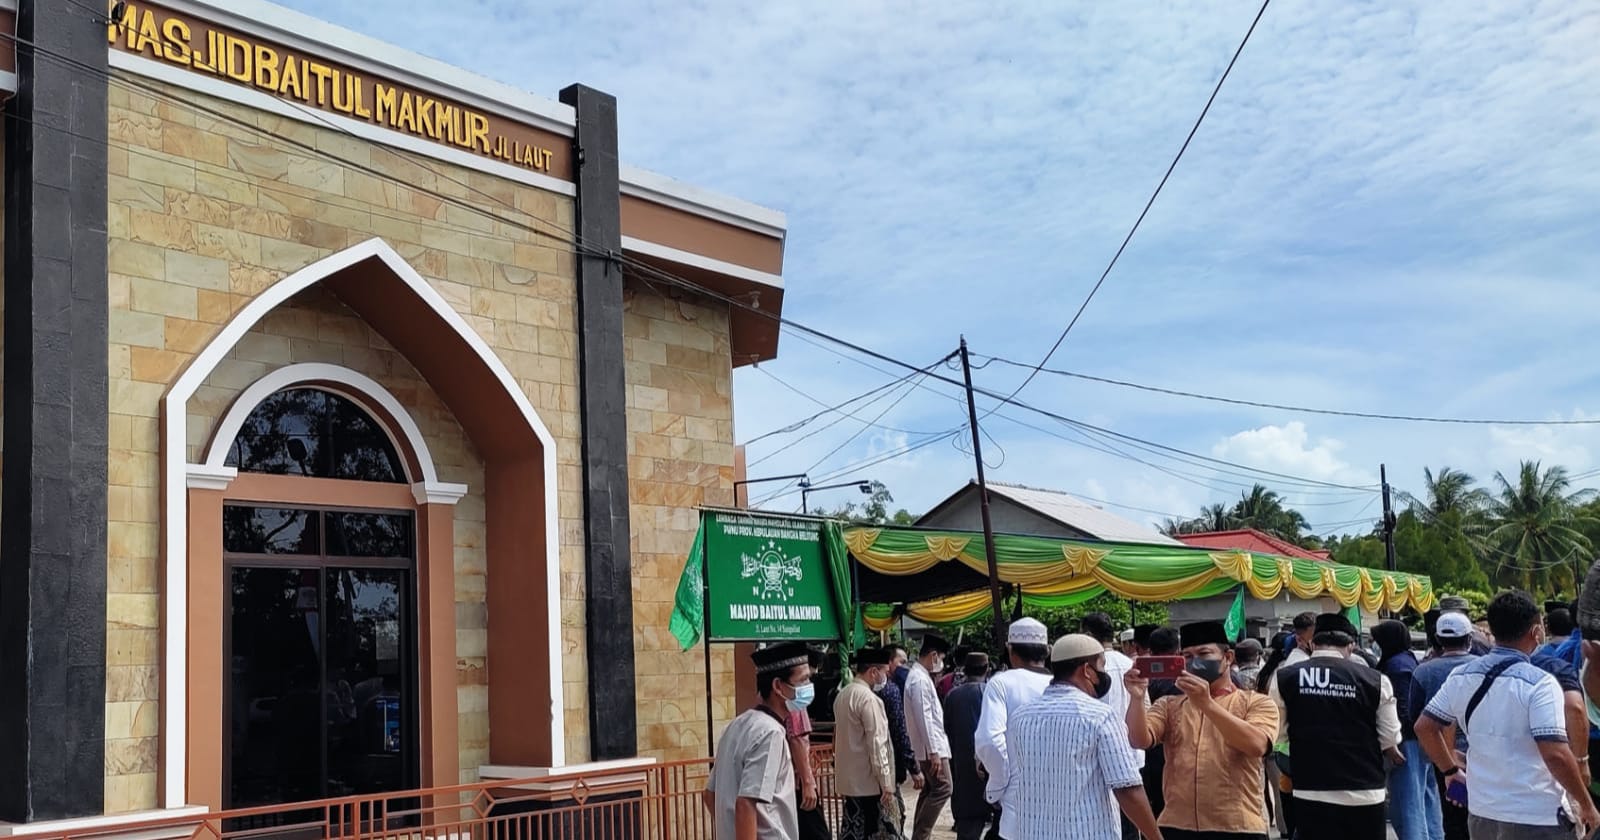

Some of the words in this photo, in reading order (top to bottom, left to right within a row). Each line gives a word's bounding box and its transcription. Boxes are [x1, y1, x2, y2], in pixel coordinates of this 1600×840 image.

[375, 83, 491, 153] MAKMUR
[494, 135, 511, 159] JL
[514, 141, 553, 171] LAUT
[752, 586, 759, 596] N
[788, 587, 794, 597] U
[730, 603, 759, 621] MASJID
[759, 604, 788, 620] BAITUL
[788, 605, 822, 621] MAKMUR
[1299, 667, 1330, 688] NU
[1329, 683, 1356, 692] PEDULI
[1299, 687, 1356, 698] KEMANUSIAAN
